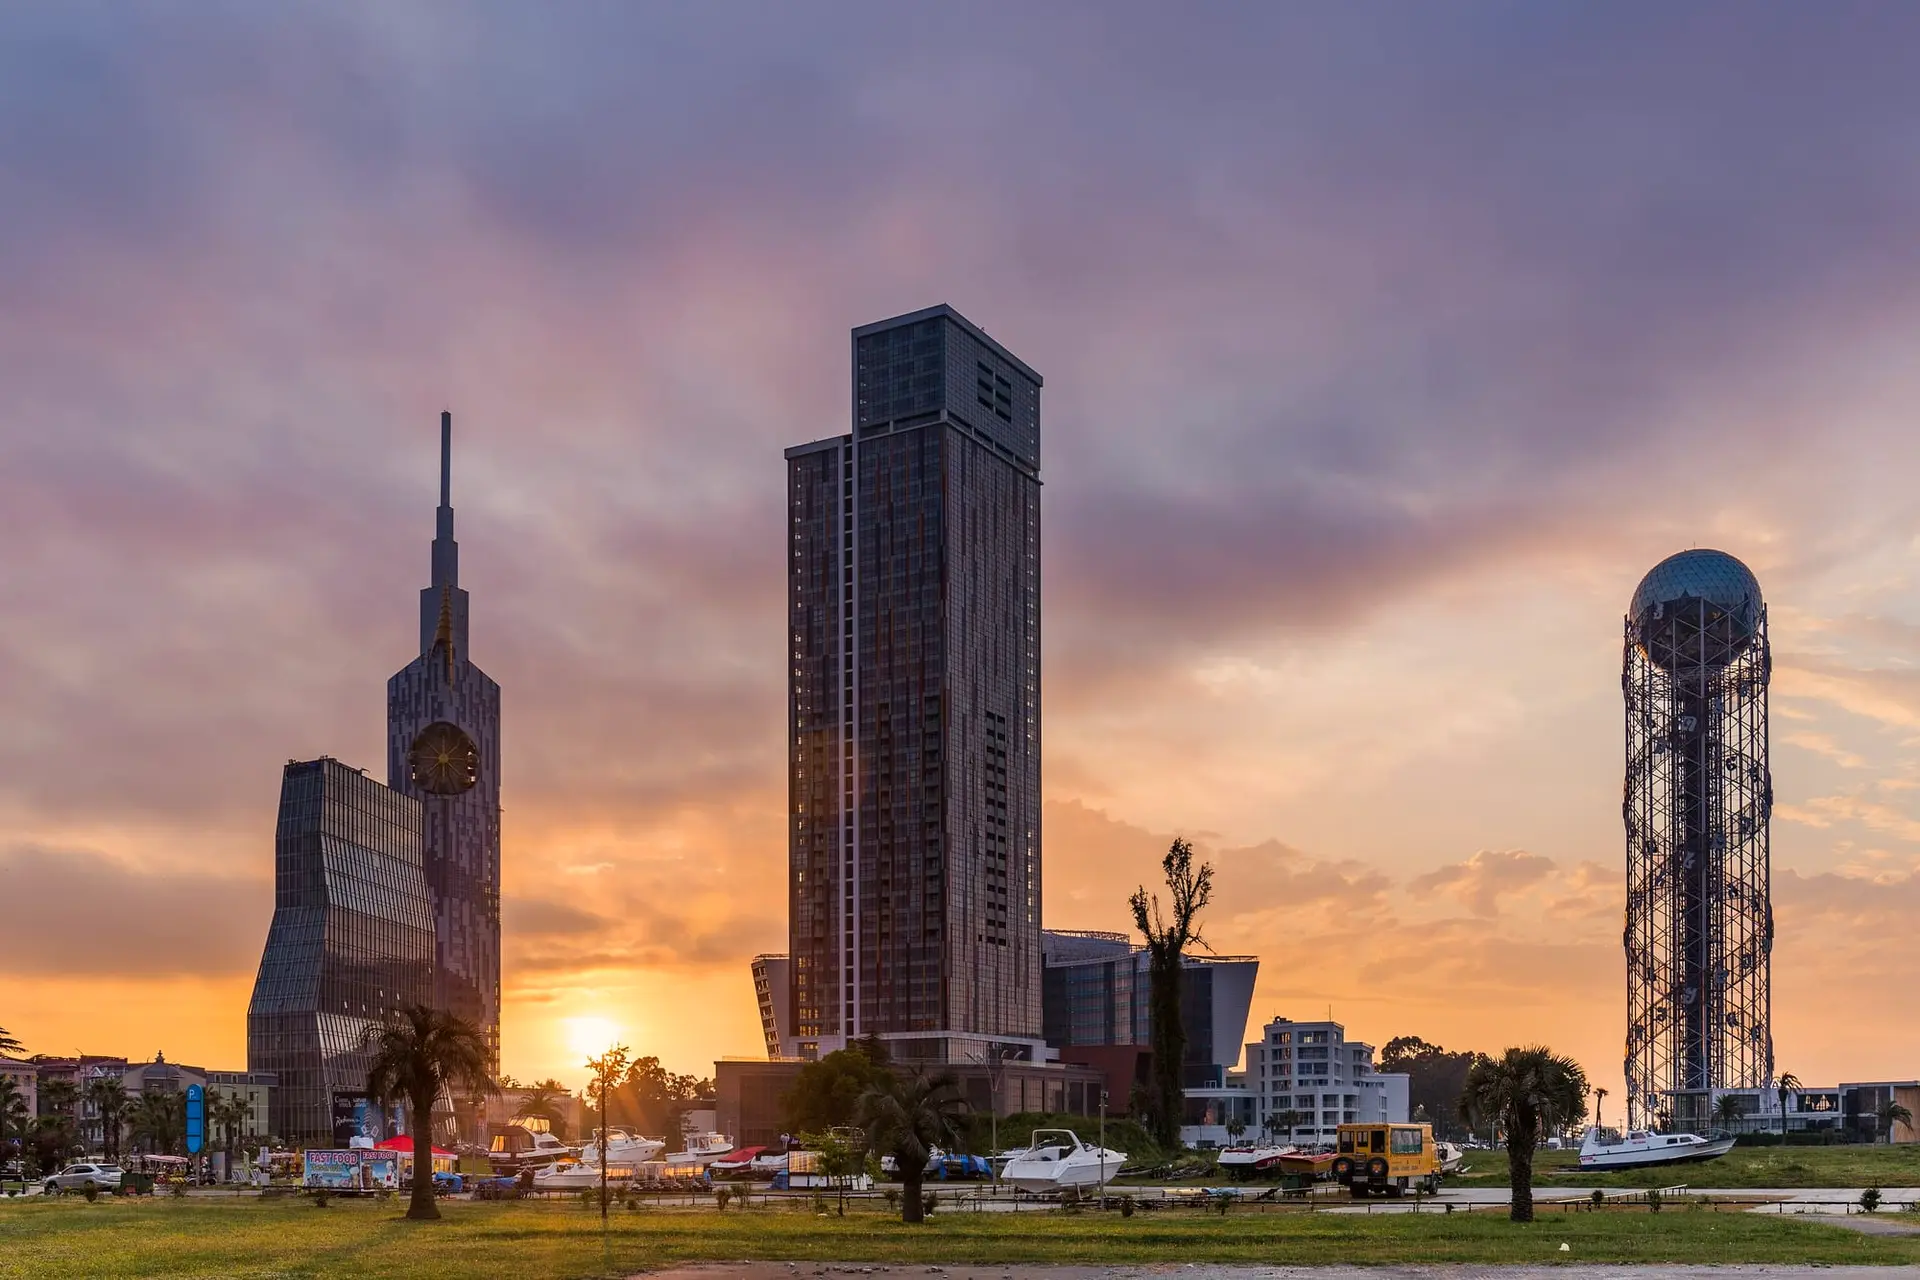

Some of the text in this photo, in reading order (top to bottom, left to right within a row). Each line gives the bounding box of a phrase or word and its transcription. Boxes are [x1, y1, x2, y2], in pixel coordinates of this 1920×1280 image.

[310, 1152, 357, 1165] FAST FOOD
[362, 1152, 377, 1160] FAST
